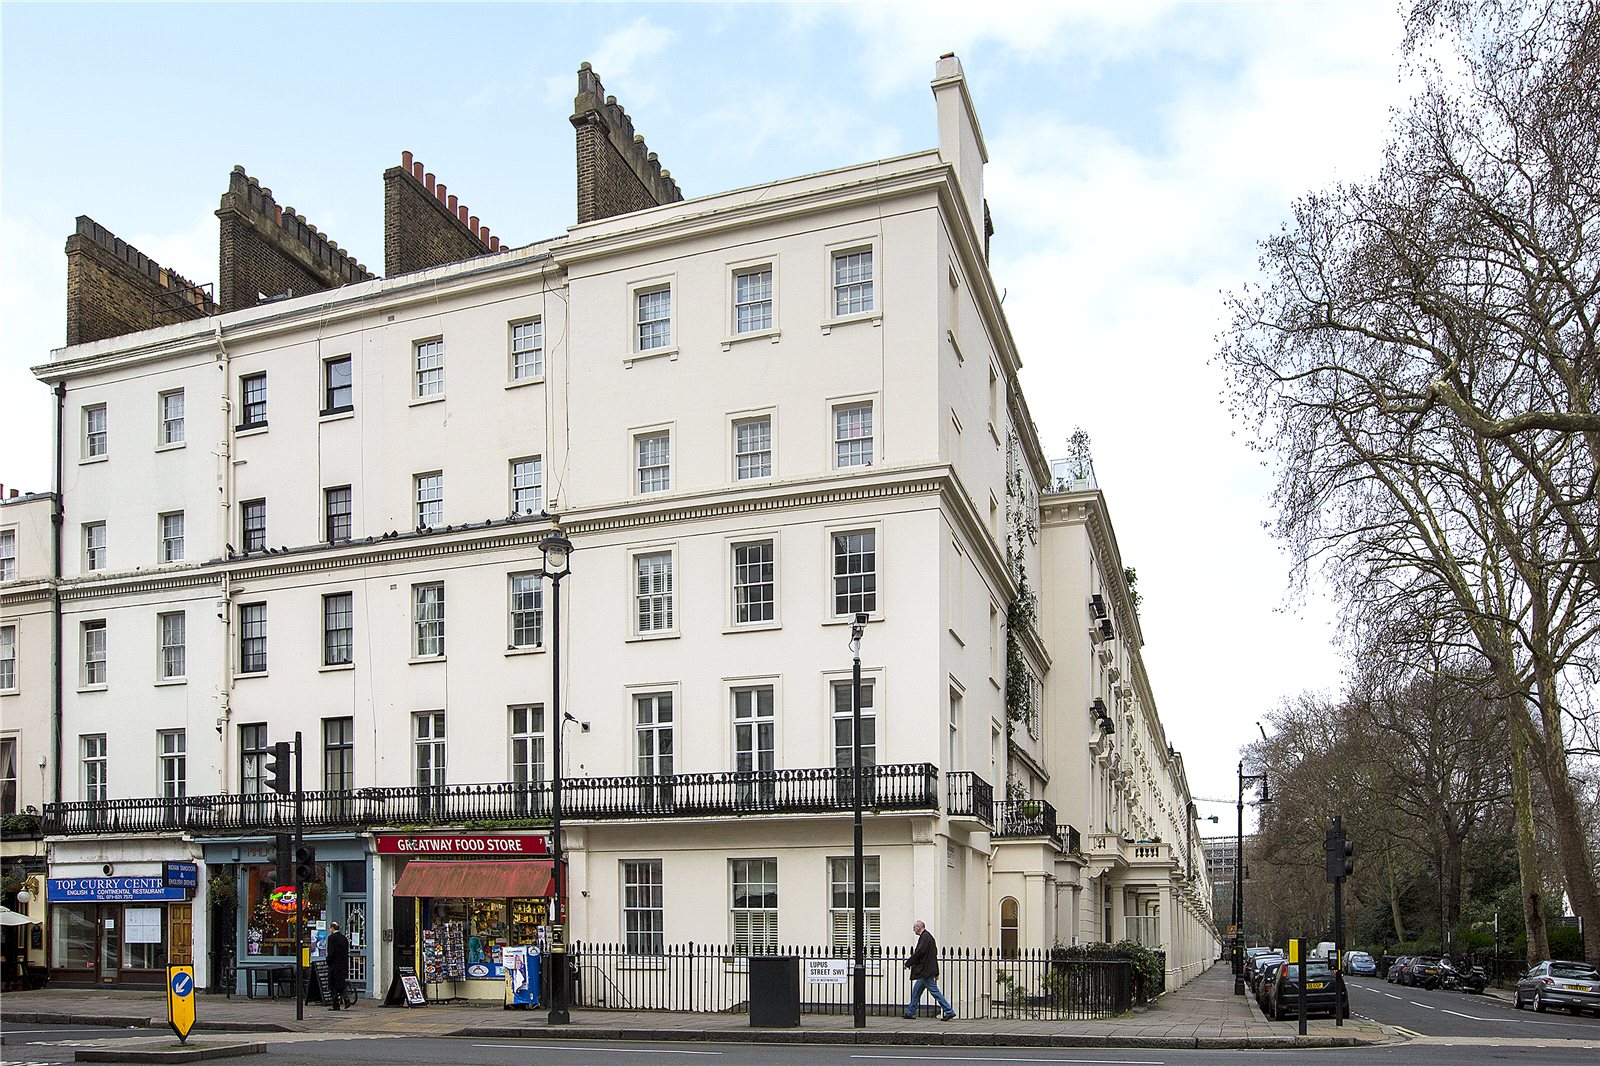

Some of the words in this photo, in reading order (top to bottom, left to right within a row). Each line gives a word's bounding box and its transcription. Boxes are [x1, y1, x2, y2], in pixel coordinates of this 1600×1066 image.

[397, 838, 453, 851] GREATWAY
[454, 838, 485, 851] FOOD
[487, 838, 523, 851] STORE
[56, 880, 77, 890] TOP
[80, 879, 120, 890] CURRY
[124, 878, 163, 888] CENTR
